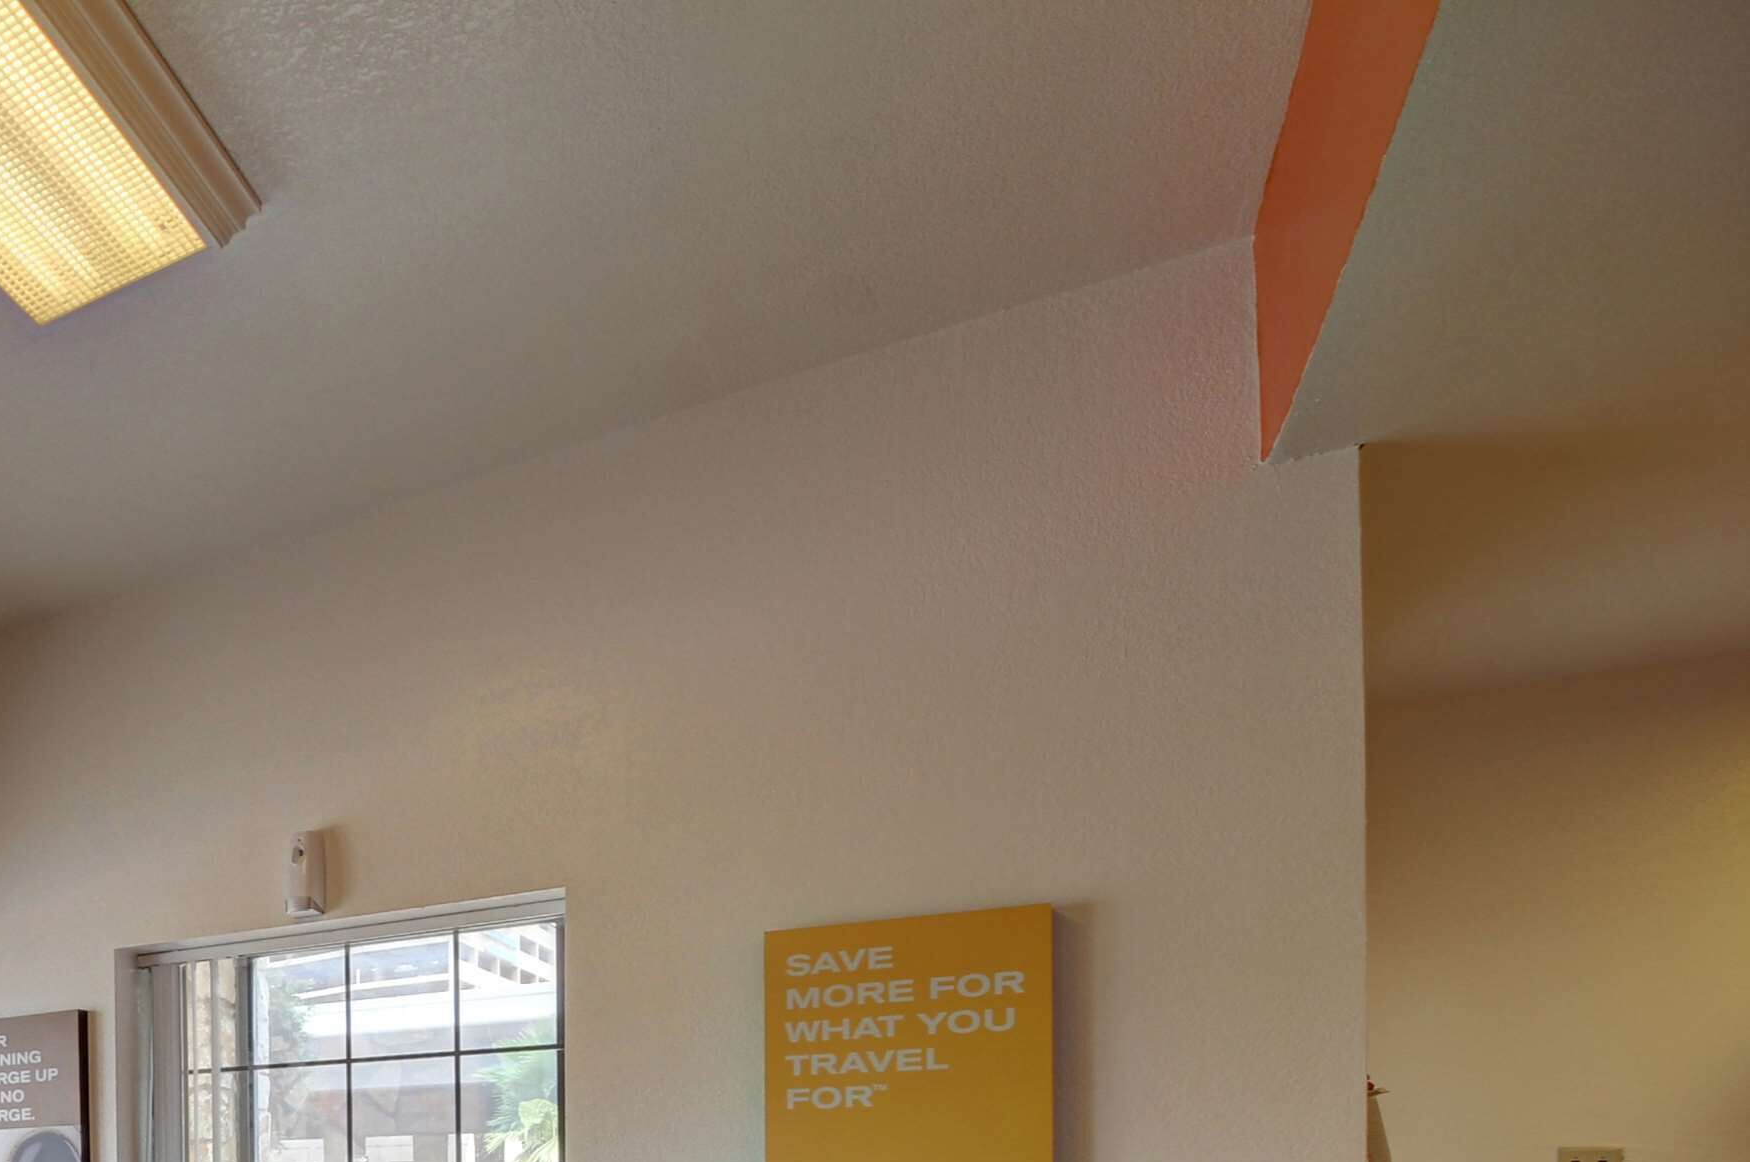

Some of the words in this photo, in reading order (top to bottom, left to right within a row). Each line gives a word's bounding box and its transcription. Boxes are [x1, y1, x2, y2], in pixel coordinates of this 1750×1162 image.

[785, 946, 894, 977] SAVE
[786, 979, 914, 1010] MORE
[930, 971, 1025, 1000] FOR
[784, 1015, 904, 1043] WHAT
[917, 1007, 1016, 1036] YOU
[35, 1068, 58, 1082] UP
[785, 1047, 949, 1076] TRAVEL
[0, 1089, 25, 1103] NO
